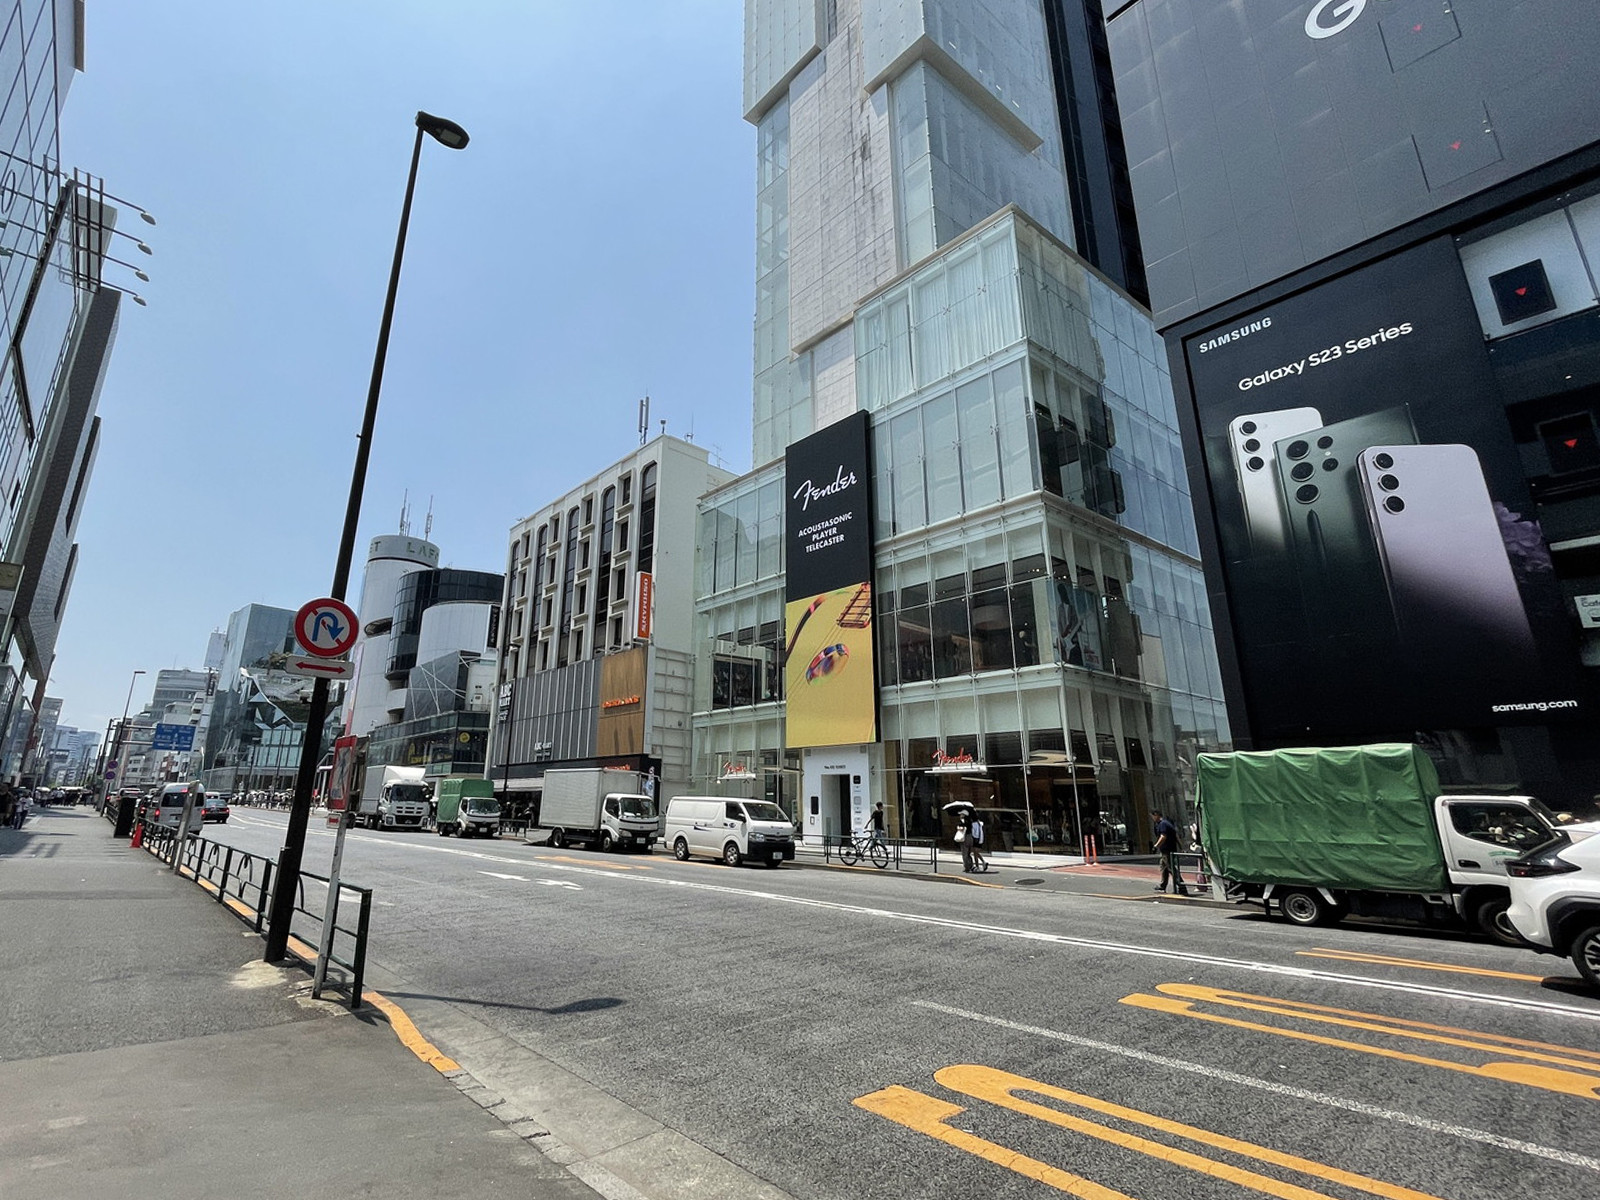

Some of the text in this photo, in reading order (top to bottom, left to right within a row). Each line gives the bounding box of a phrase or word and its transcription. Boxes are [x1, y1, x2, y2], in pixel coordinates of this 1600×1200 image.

[1199, 317, 1272, 353] SAMSUNG
[1238, 322, 1413, 391] Galaxy S23 Series
[793, 464, 858, 511] Fender
[798, 511, 853, 538] ACOUSTASONIC
[812, 527, 837, 541] PLAYER
[805, 534, 845, 553] TELECASTER
[1491, 699, 1578, 712] samsung.com
[932, 747, 974, 767] Fender
